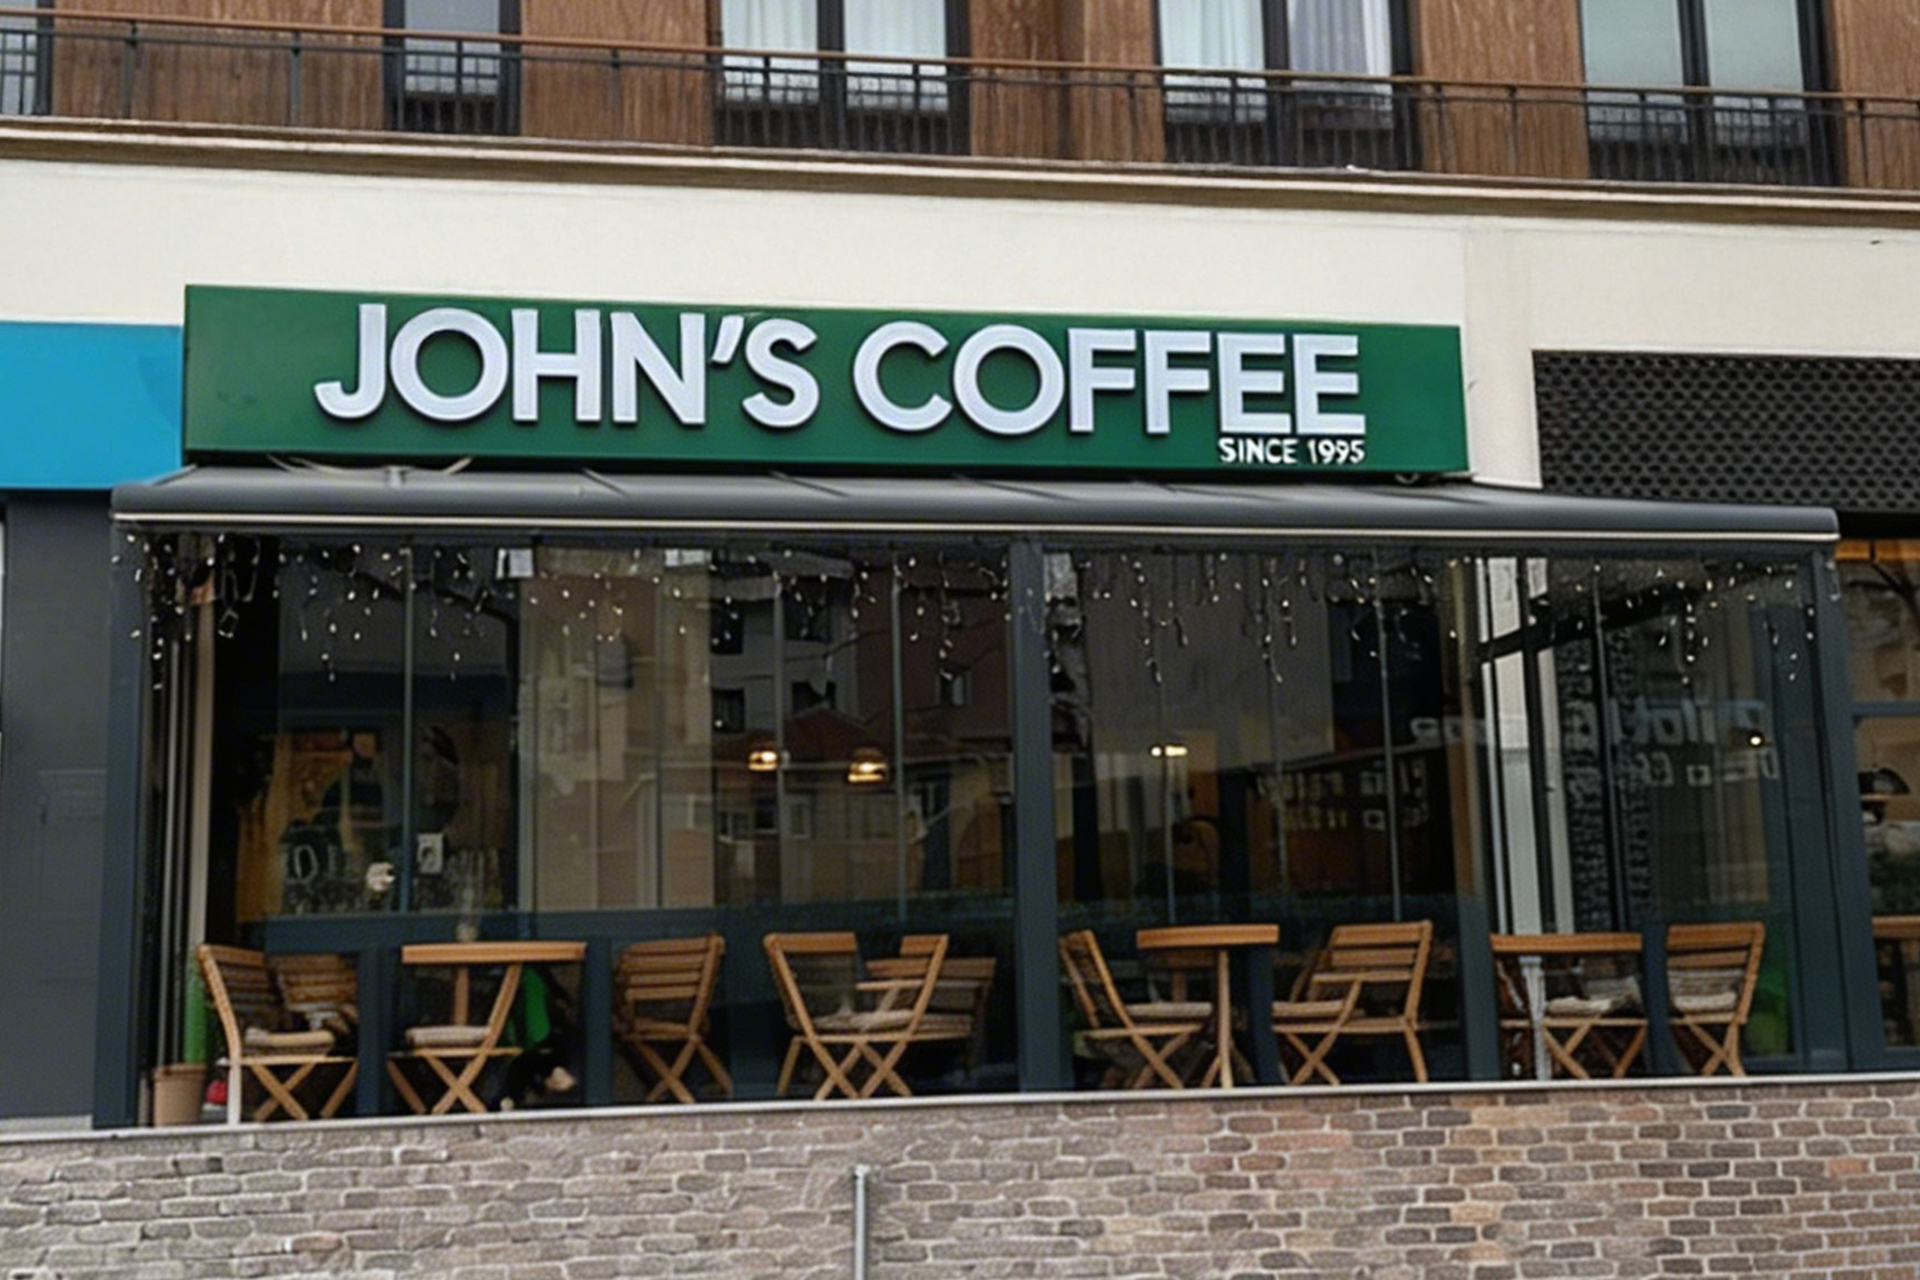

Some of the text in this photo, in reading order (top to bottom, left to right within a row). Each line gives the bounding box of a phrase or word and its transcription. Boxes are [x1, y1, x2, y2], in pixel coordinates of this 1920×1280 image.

[314, 303, 1366, 435] JOHN'S COFFEE
[1218, 437, 1365, 464] SINCE 1995
